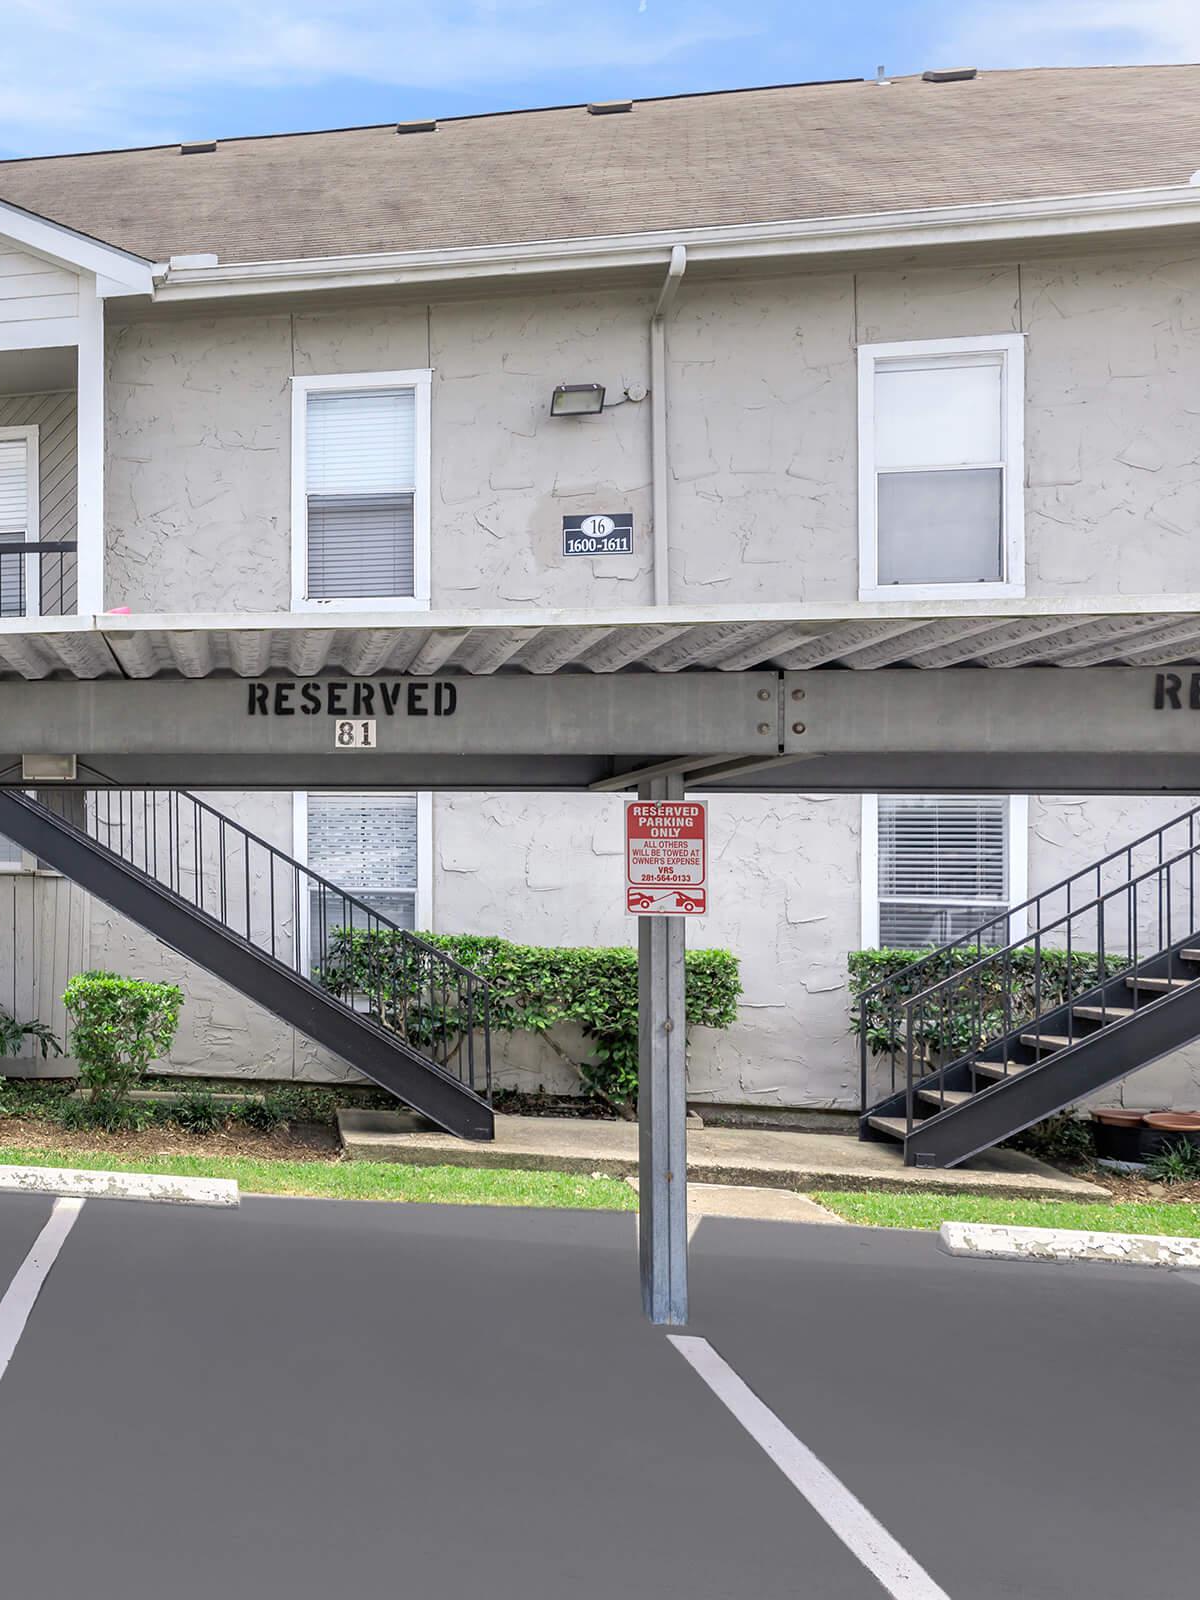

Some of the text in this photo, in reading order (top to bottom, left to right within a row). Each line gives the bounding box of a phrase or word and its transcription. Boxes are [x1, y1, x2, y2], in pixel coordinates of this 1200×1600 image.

[590, 518, 606, 534] 16
[567, 537, 629, 553] 1600-1611
[248, 682, 458, 716] RESERVED
[337, 721, 372, 746] 81
[633, 806, 699, 816] RESERVED
[638, 817, 694, 827] PARKING
[650, 828, 681, 837] ONLY
[662, 849, 689, 857] TOWED
[690, 849, 700, 857] AT
[666, 857, 700, 865] EXPENSE
[657, 866, 674, 874] VRS
[641, 874, 691, 882] 281-564-0133
